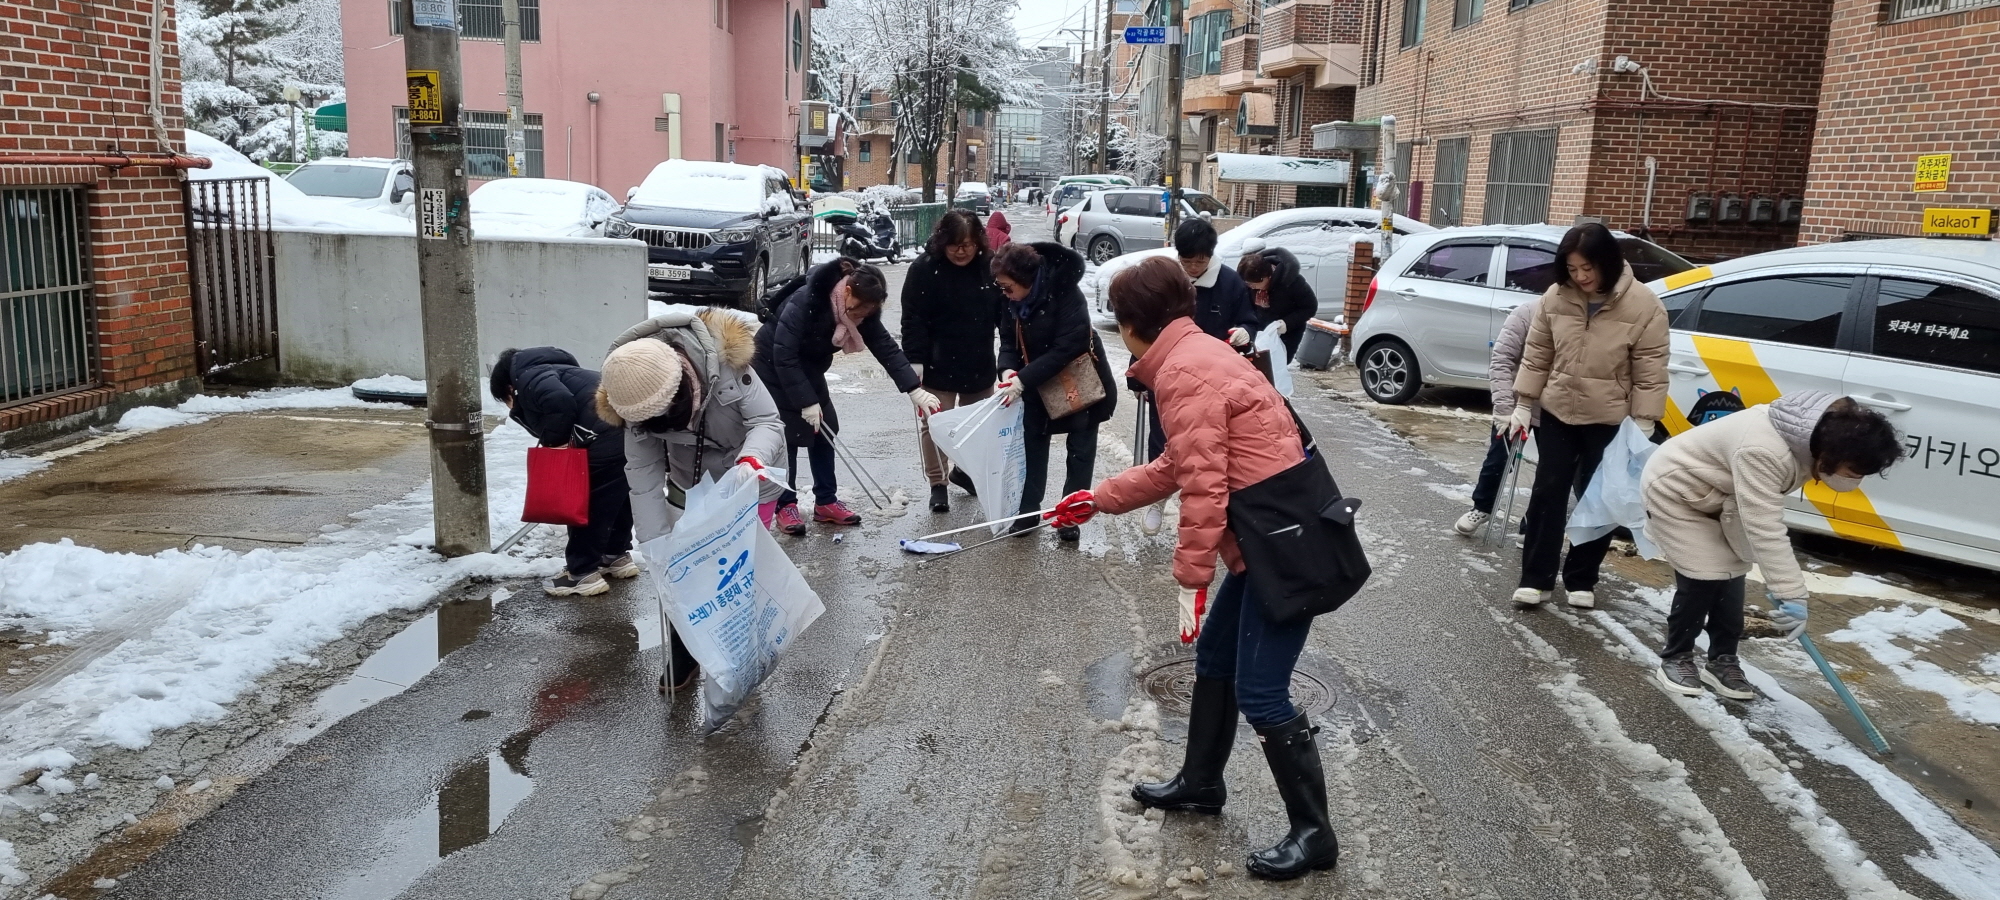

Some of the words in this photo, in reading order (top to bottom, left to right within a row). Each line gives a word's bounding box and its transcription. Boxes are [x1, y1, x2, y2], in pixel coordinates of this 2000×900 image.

[1920, 157, 1949, 169] 거주자외
[1918, 169, 1947, 181] 주차금지
[423, 190, 435, 237] 사다리차
[667, 269, 687, 279] 3598
[1888, 320, 1922, 334] 뒷좌석
[1924, 324, 1970, 340] 타주세요
[1905, 434, 2000, 479] 카카오
[688, 600, 718, 626] 쓰레기
[715, 582, 743, 608] 종량제
